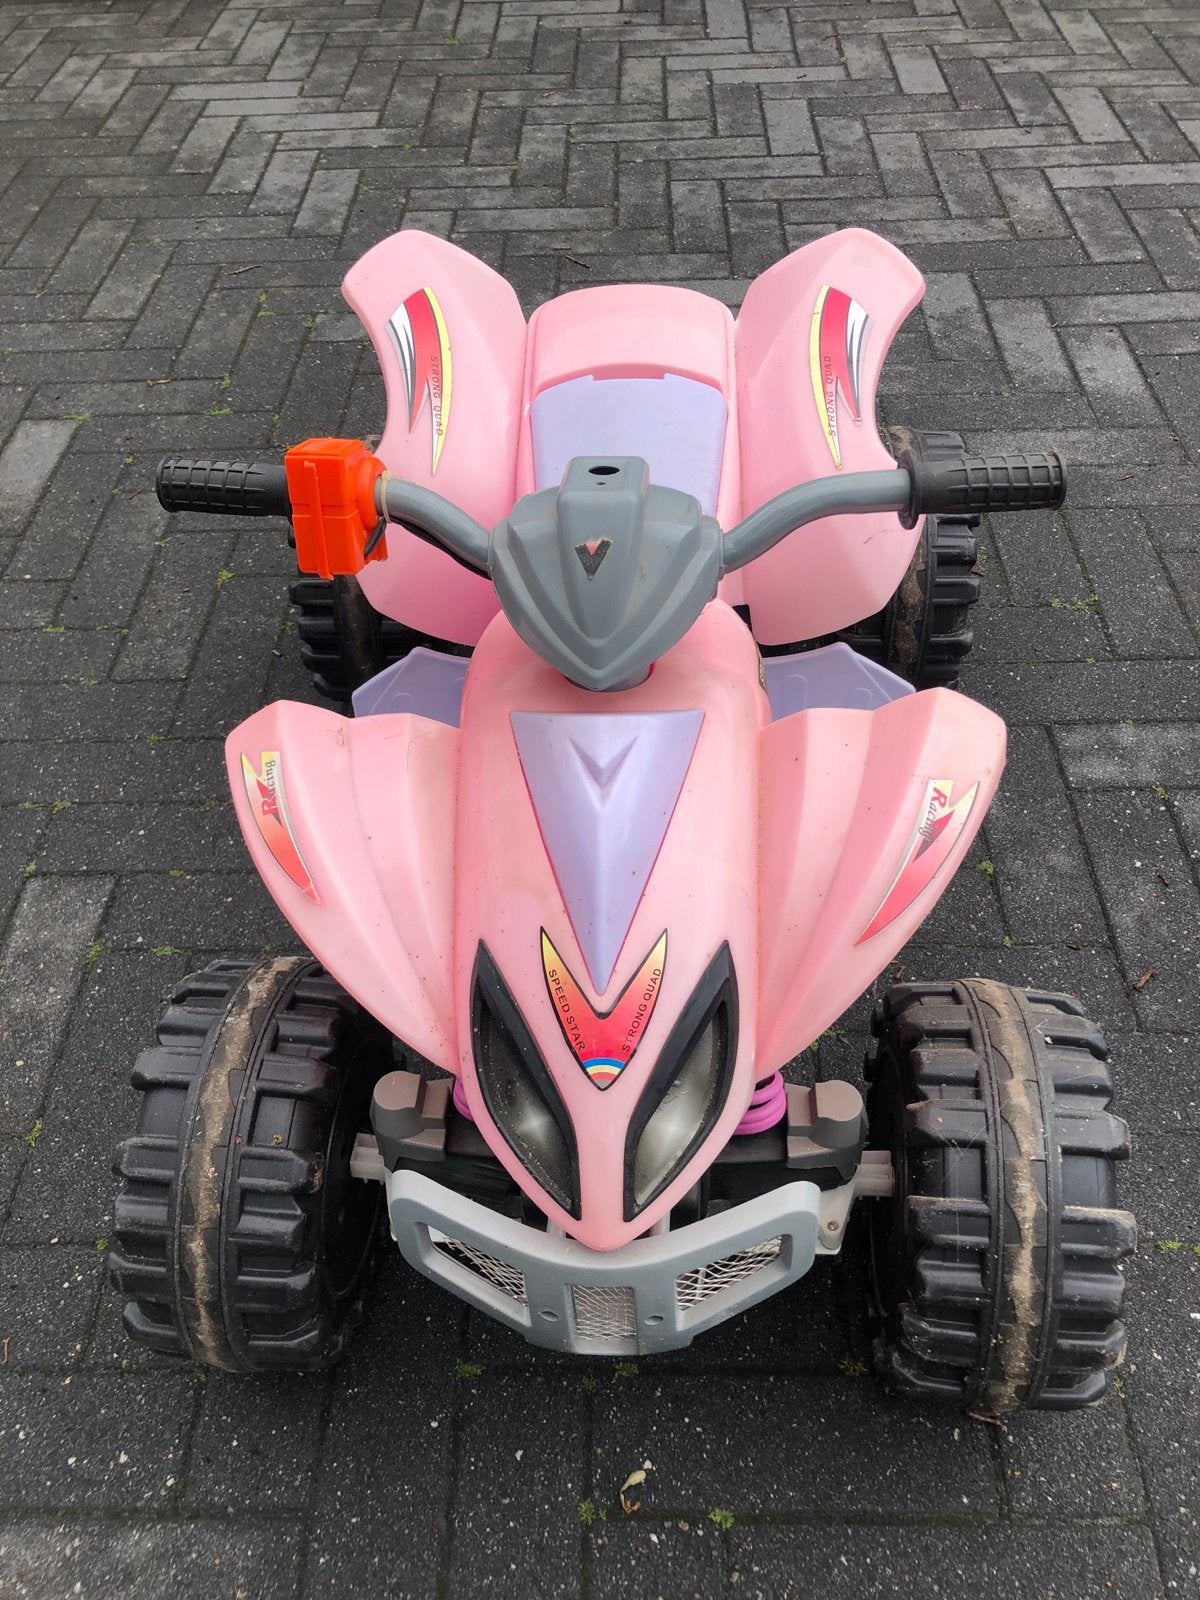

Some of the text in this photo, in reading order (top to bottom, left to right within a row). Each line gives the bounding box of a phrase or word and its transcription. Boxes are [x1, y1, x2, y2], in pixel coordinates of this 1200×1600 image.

[430, 355, 443, 436] STRONG QUAD
[824, 355, 837, 437] STRONG QUAD
[262, 759, 279, 816] Racing
[549, 969, 586, 1051] SPEED STAR
[622, 968, 662, 1052] STRONG QUAD
